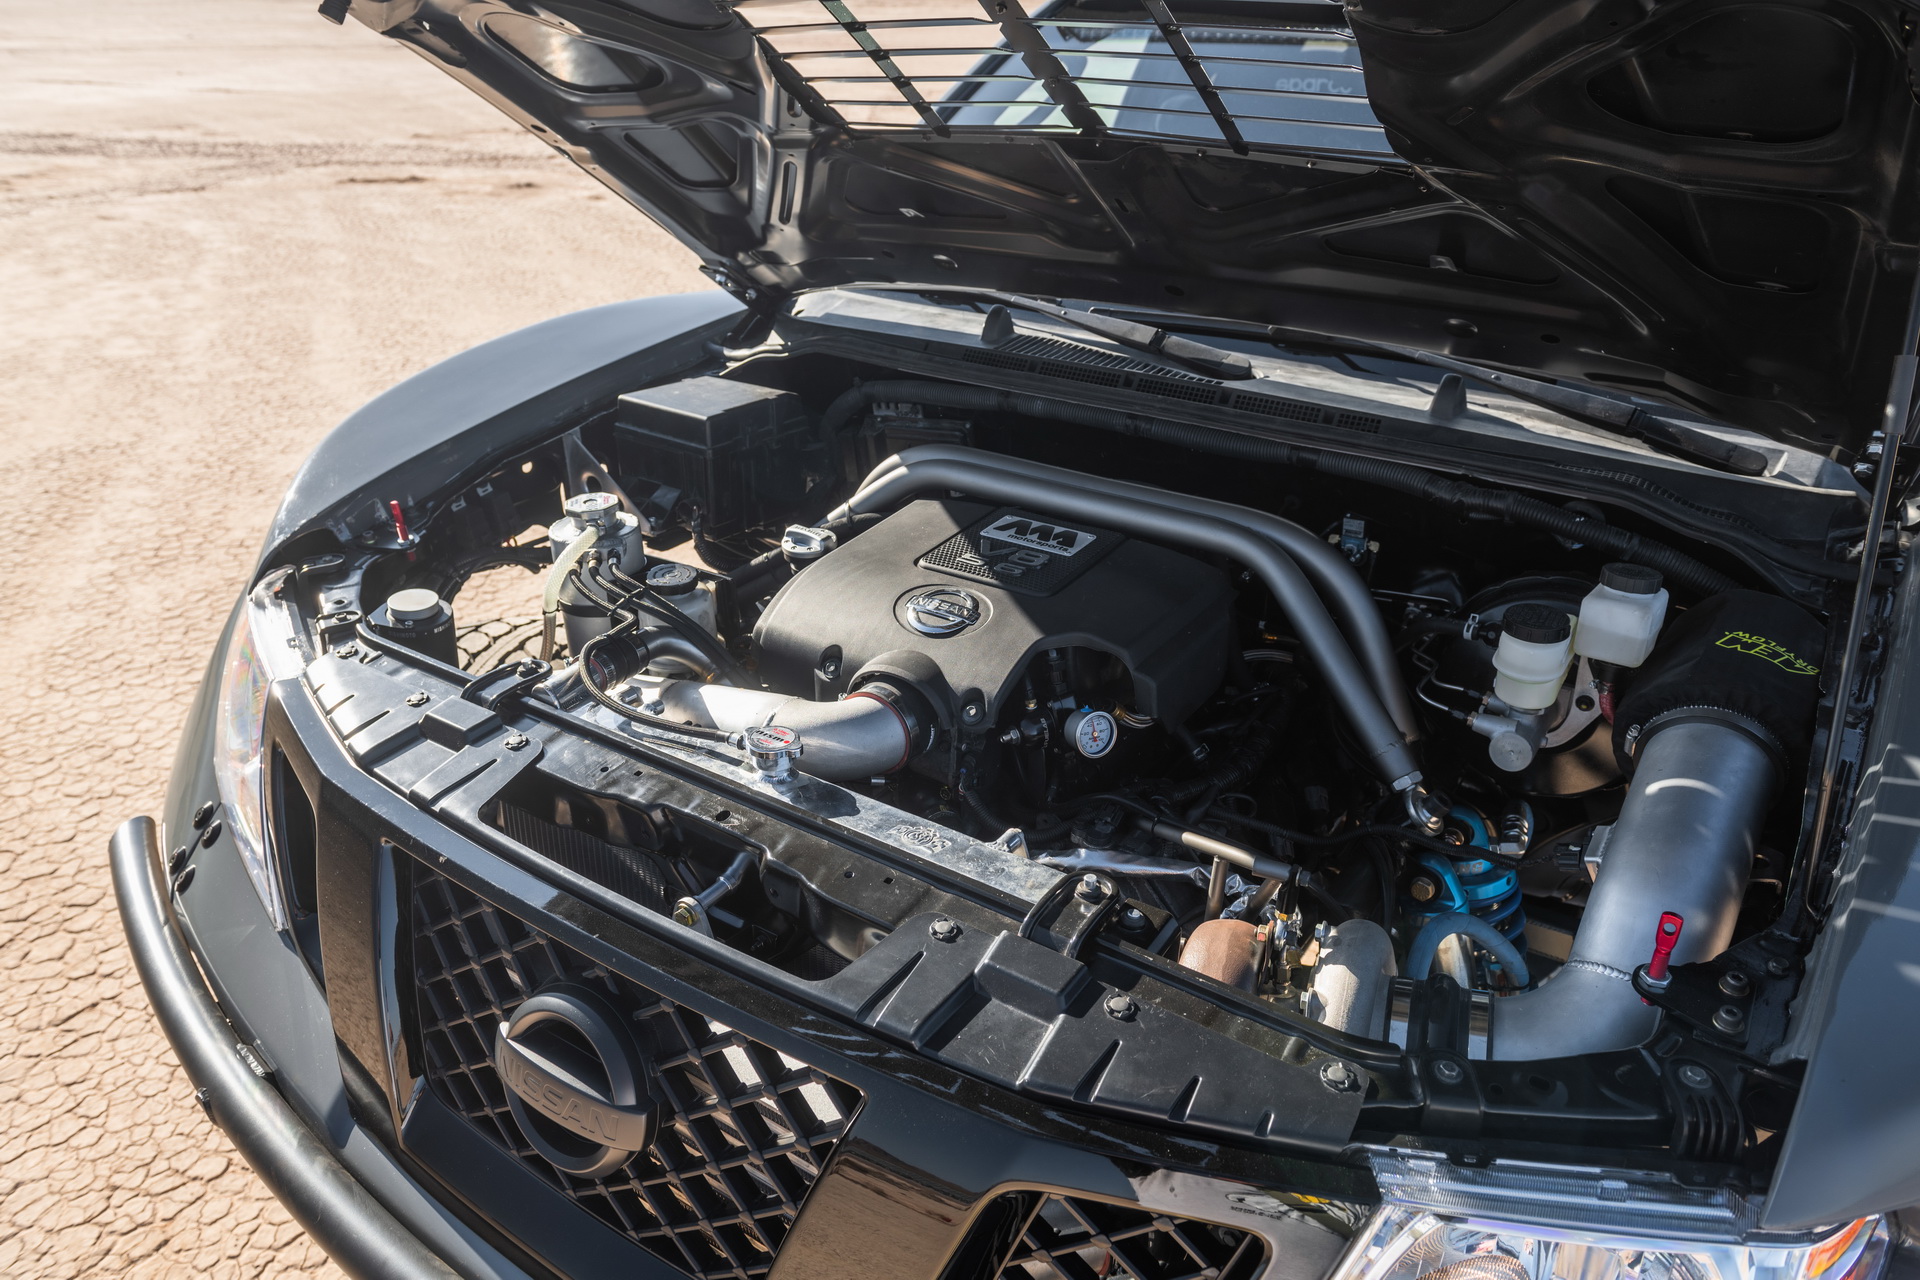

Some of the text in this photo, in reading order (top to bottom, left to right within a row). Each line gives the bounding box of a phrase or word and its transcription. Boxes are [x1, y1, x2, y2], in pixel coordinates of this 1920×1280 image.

[980, 539, 1050, 569] V8
[1007, 533, 1069, 552] motorsports
[915, 597, 971, 618] NISSAN
[1733, 631, 1821, 673] DRYFLOW
[755, 730, 791, 744] nismo
[498, 1045, 620, 1142] NISSAN
